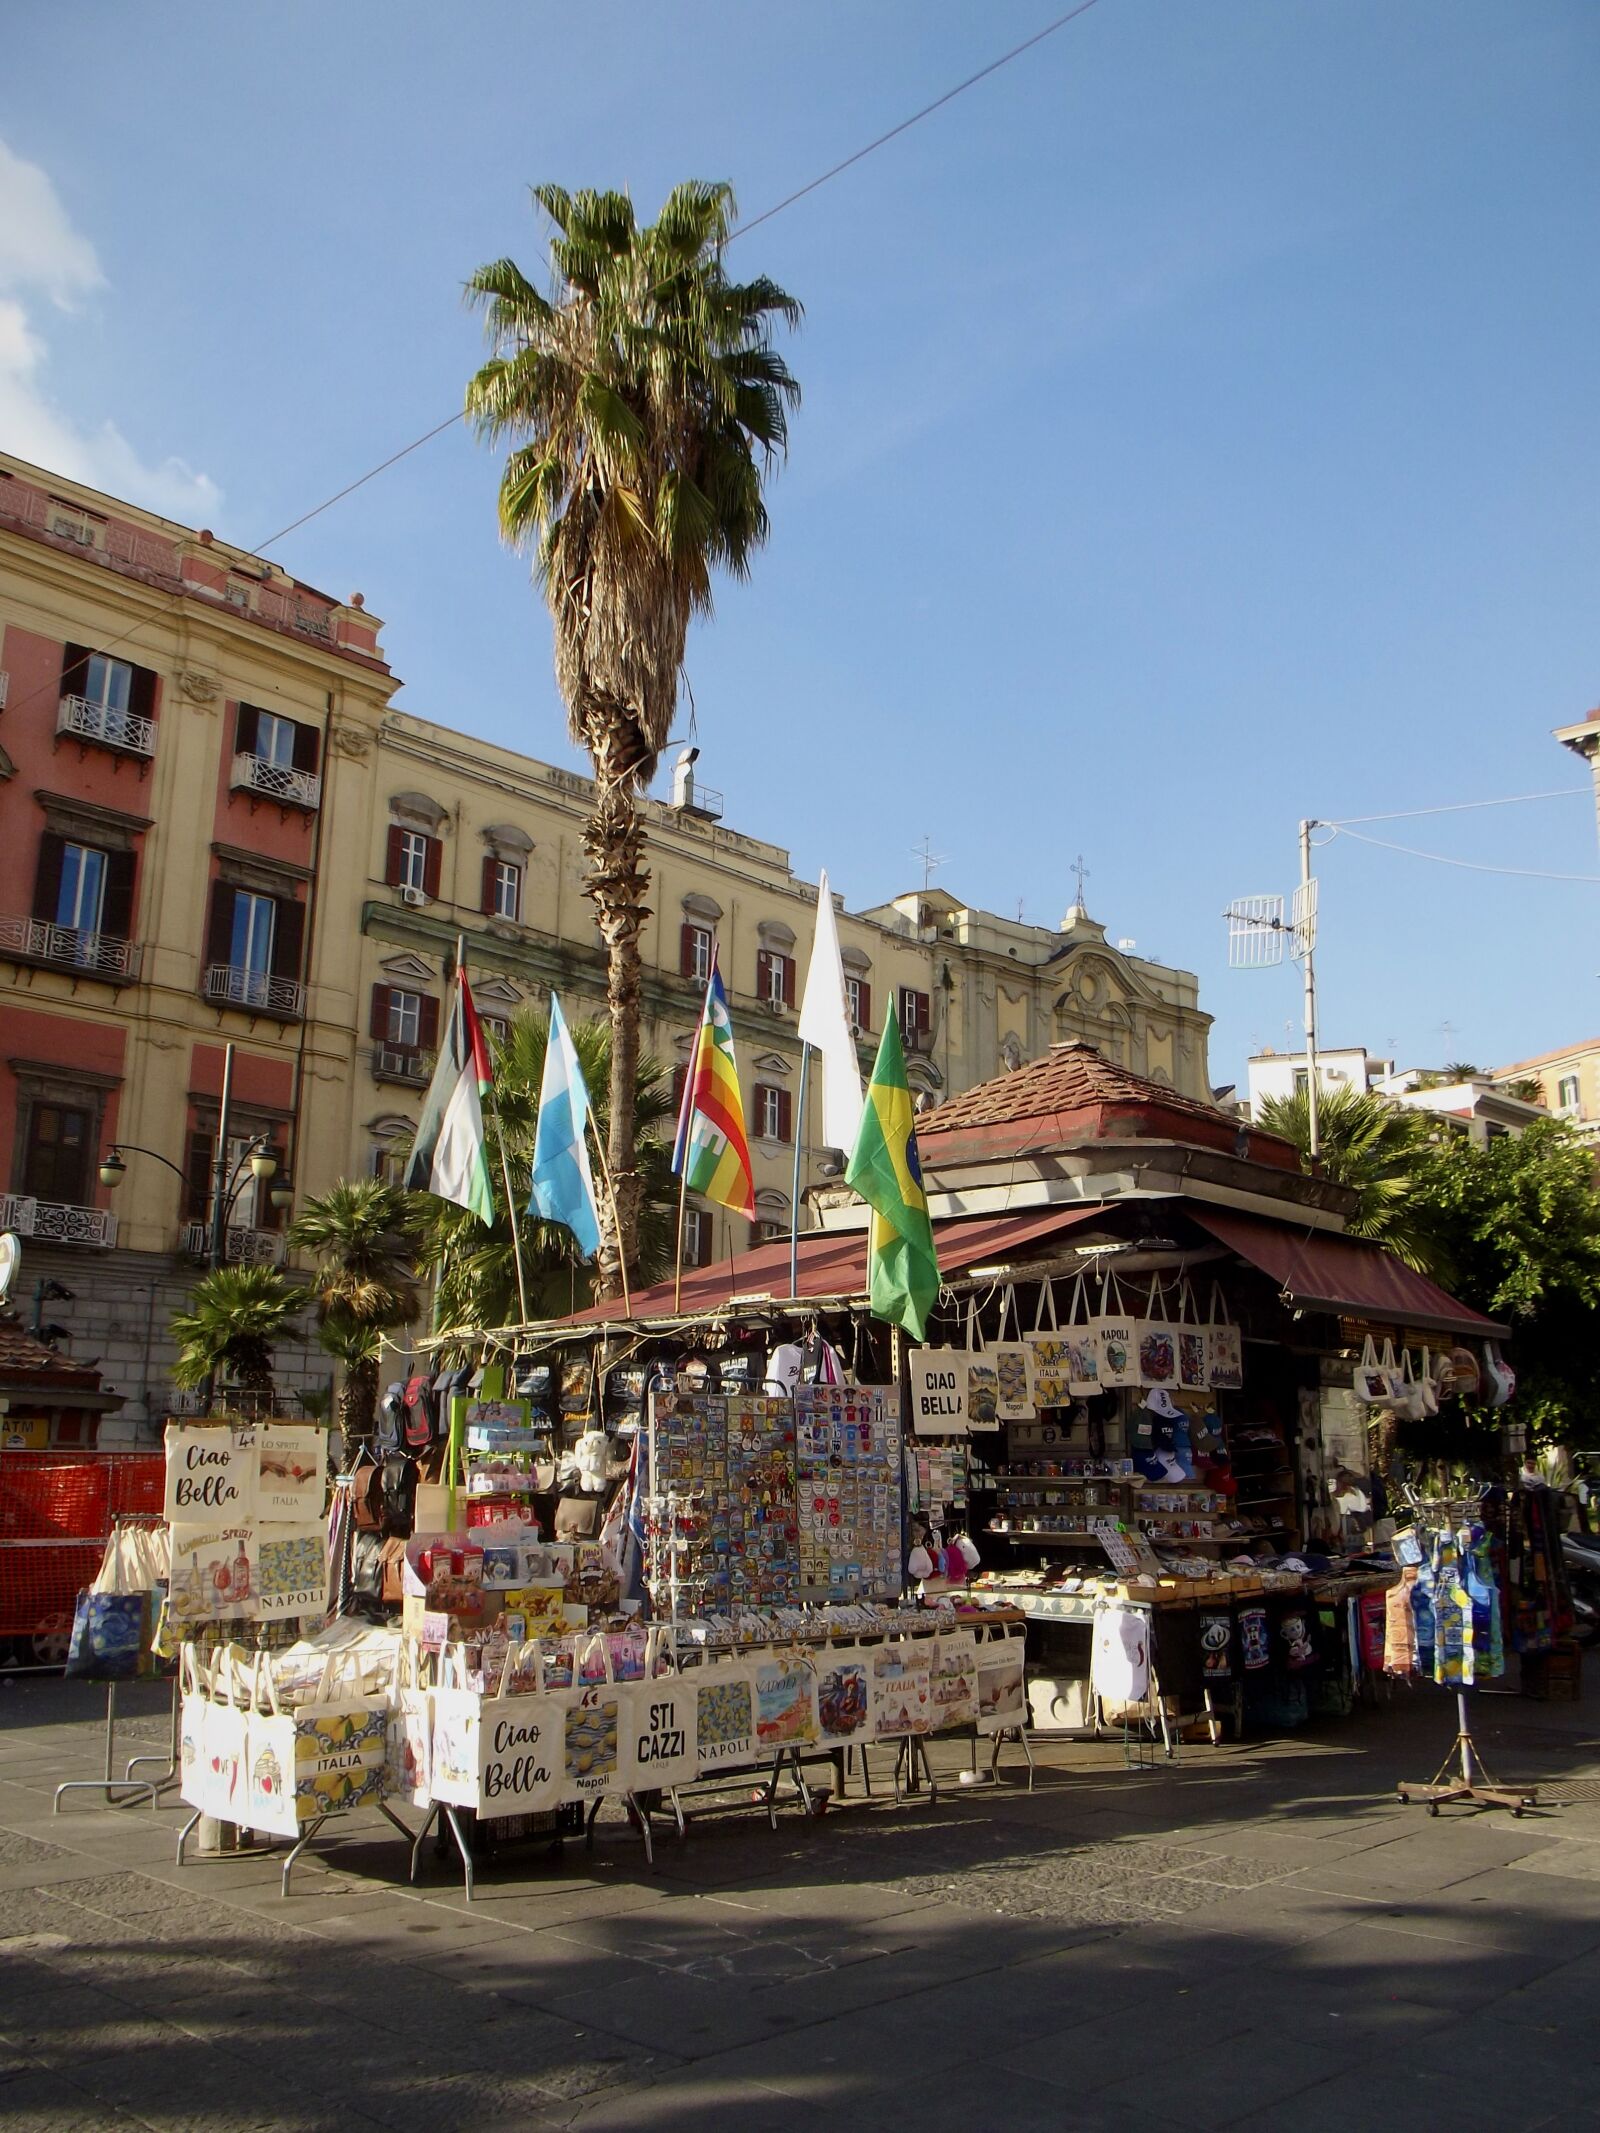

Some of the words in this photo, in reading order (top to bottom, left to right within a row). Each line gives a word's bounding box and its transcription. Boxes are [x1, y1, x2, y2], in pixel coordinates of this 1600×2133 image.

[1101, 1329, 1129, 1341] NAPOLI
[925, 1372, 956, 1390] CIAO
[1039, 1369, 1060, 1378] ITALIA
[1005, 1401, 1024, 1411] Napoli
[2, 1420, 34, 1433] ATM
[261, 1441, 274, 1449] LO
[275, 1441, 300, 1450] SPRITZ
[186, 1445, 232, 1470] Ciao
[176, 1476, 239, 1506] Bella
[272, 1496, 299, 1505] ITALIA
[221, 1529, 253, 1541] SPRITZ!
[262, 1590, 325, 1609] NAPOLI
[756, 1677, 797, 1695] NAPOLI
[885, 1679, 916, 1693] ITALIA
[580, 1690, 598, 1708] 4€
[649, 1702, 675, 1731] STI
[494, 1720, 541, 1754] Ciao
[637, 1730, 685, 1763] CAZZI
[697, 1739, 750, 1760] NAPOLI
[317, 1754, 362, 1772] ITALIA
[484, 1755, 551, 1798] Bella
[576, 1774, 610, 1789] Napoli
